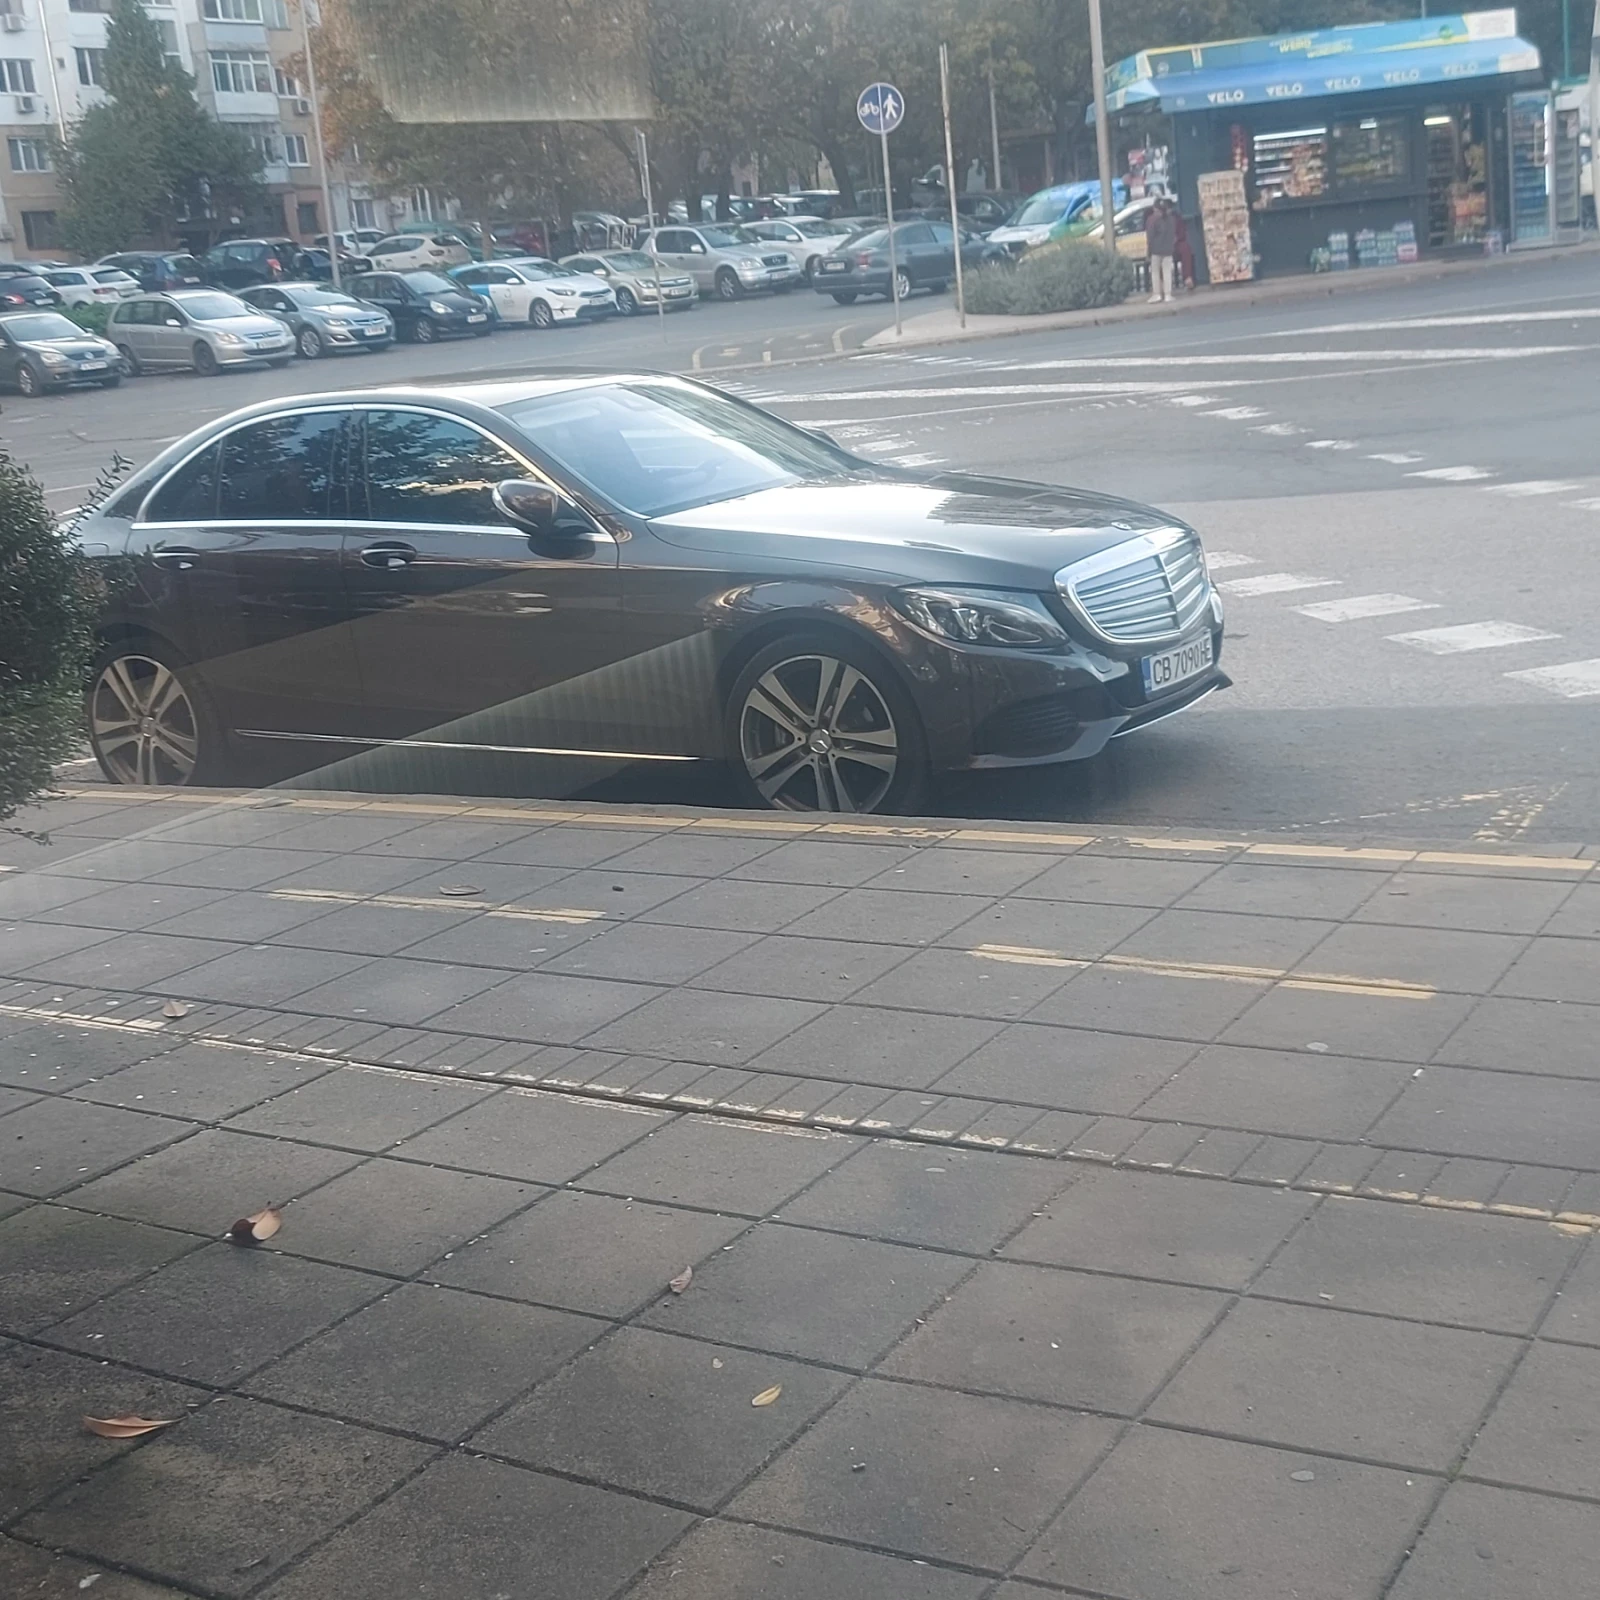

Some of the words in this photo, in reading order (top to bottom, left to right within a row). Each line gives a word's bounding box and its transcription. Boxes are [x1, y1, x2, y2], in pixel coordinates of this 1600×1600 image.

[1208, 89, 1244, 103] VELO
[1266, 82, 1303, 97] VELO
[1325, 76, 1361, 90] VELO
[1384, 68, 1420, 83] VELO
